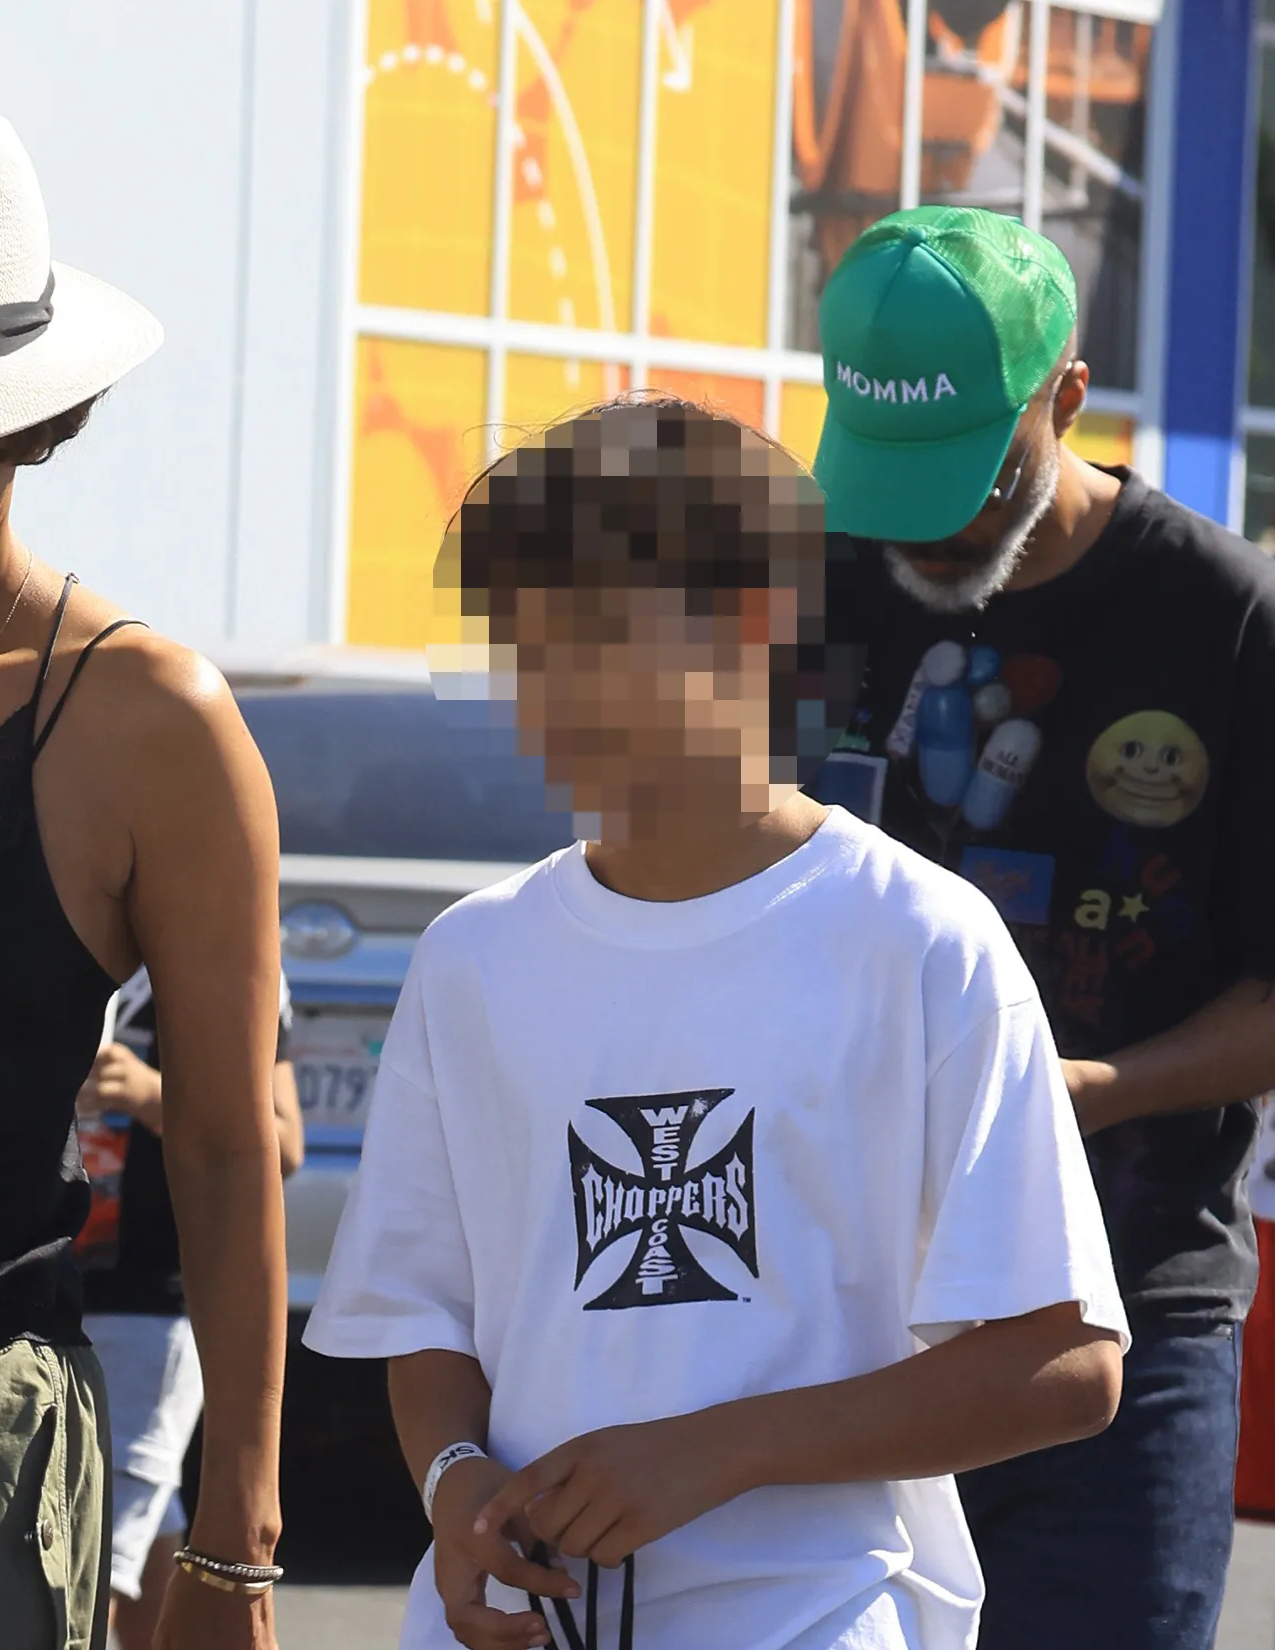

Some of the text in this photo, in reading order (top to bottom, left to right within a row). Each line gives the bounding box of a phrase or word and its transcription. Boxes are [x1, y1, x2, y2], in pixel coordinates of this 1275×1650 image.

[836, 359, 958, 404] MOMMA
[296, 1064, 378, 1113] 079
[639, 1104, 690, 1182] WEST
[580, 1151, 750, 1254] CHOPPERS
[635, 1217, 679, 1296] COAST
